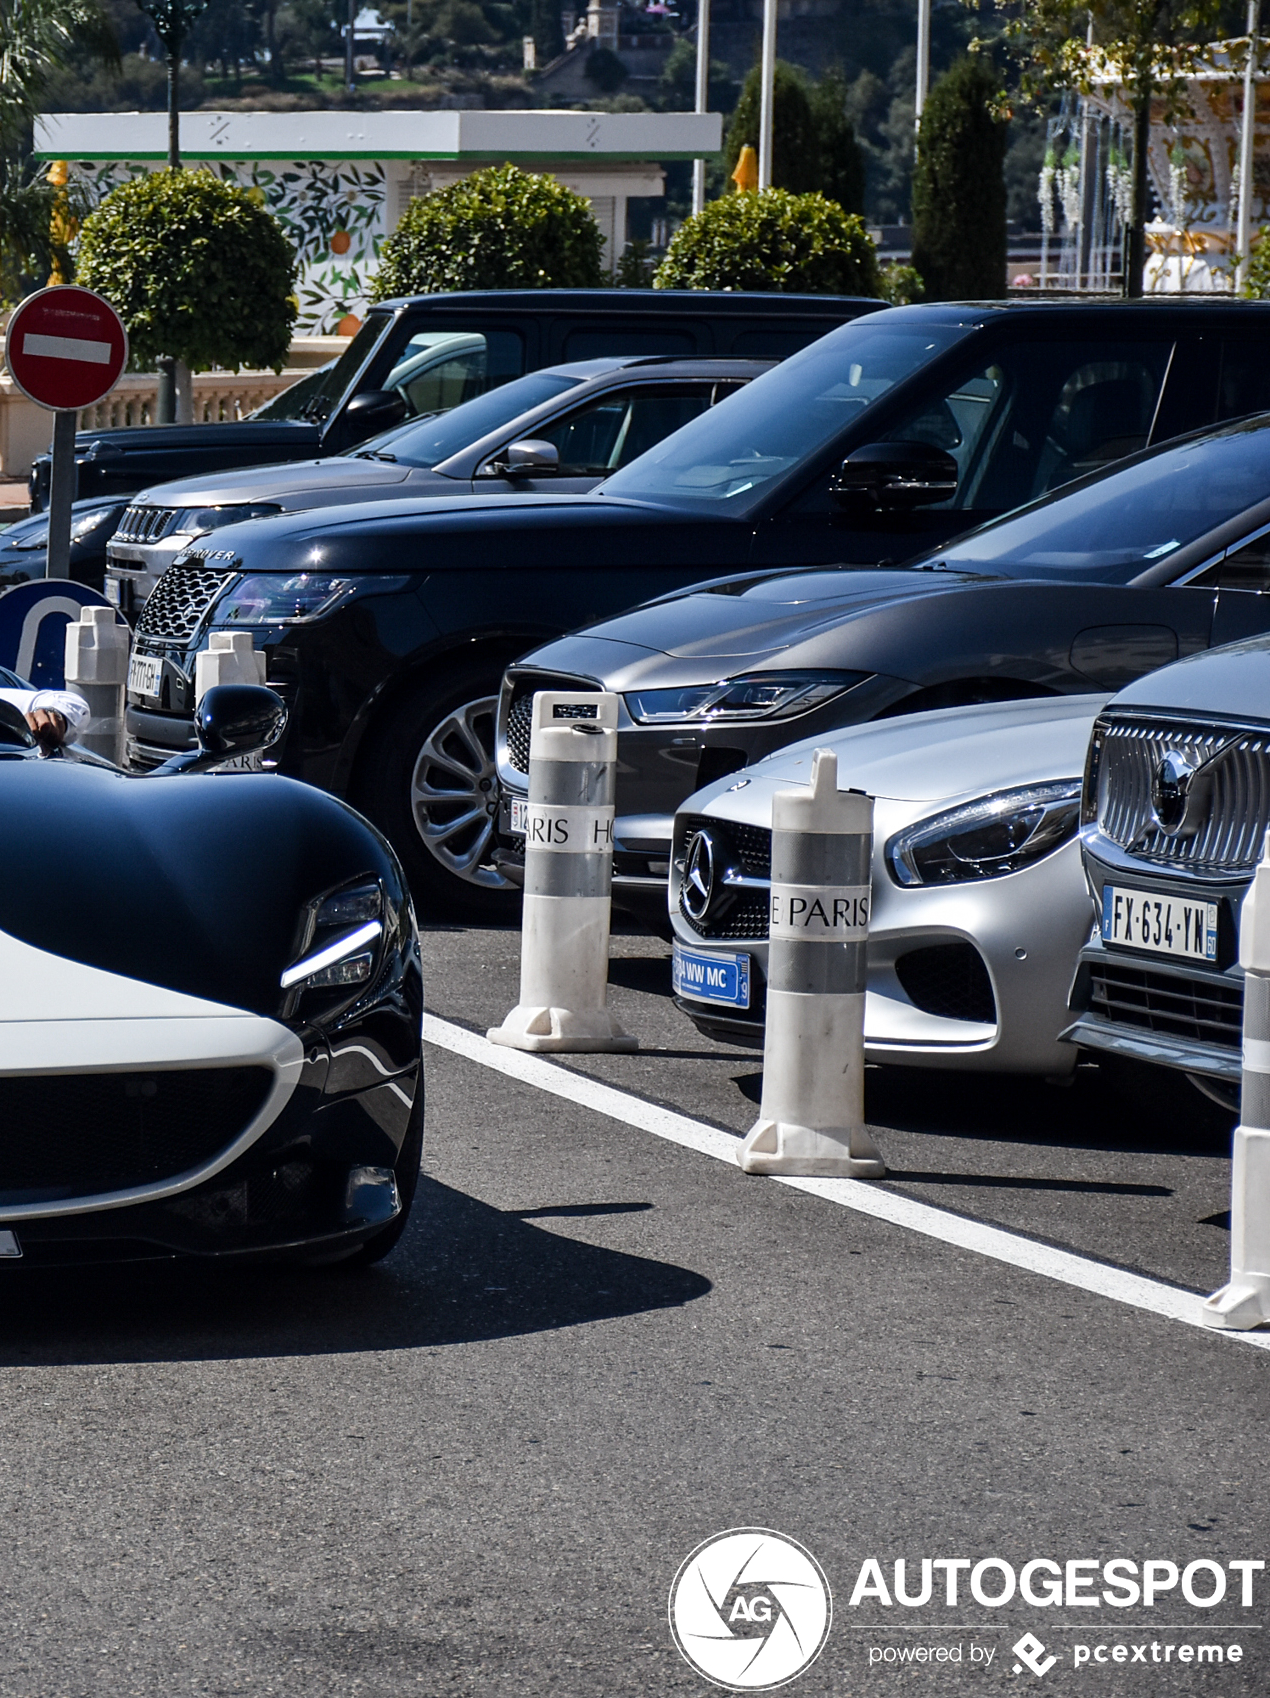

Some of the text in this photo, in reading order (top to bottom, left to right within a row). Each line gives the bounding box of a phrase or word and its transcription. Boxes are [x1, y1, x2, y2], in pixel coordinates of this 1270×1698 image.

[224, 755, 262, 771] ARIS
[789, 897, 868, 927] PARIS
[686, 961, 705, 984] WW
[707, 966, 727, 988] MC
